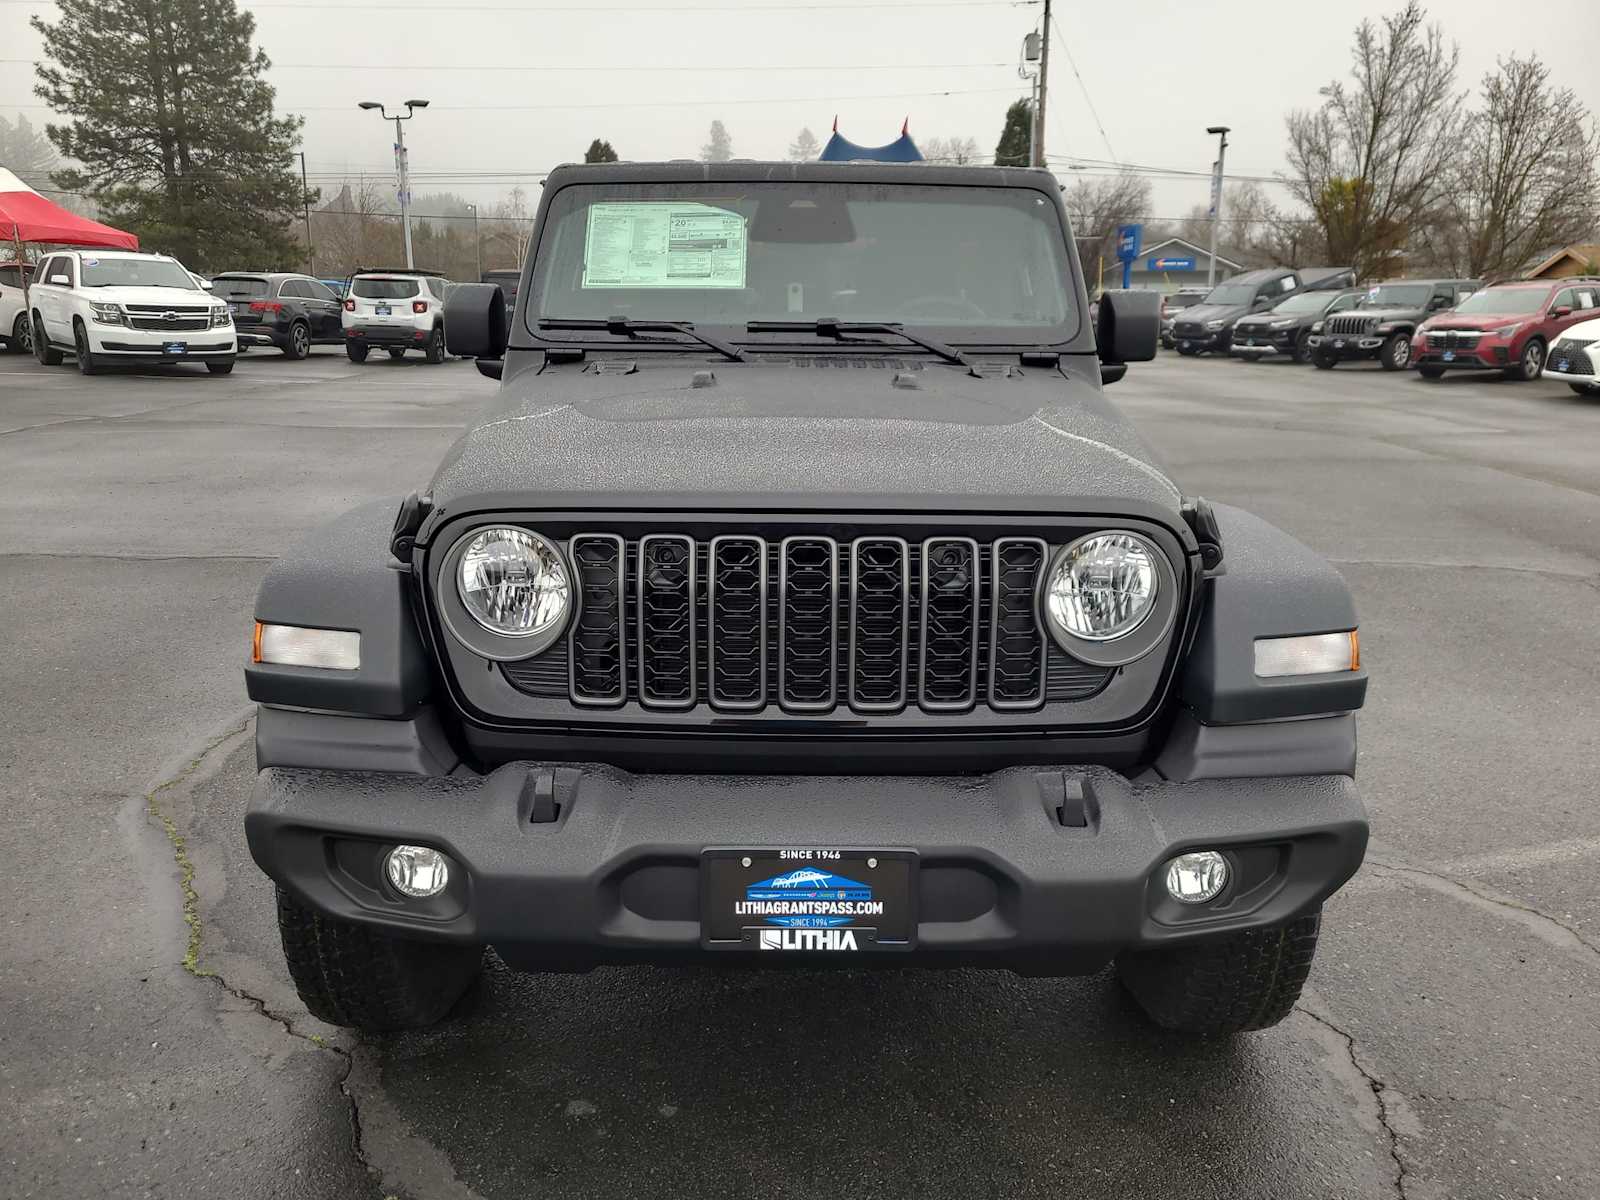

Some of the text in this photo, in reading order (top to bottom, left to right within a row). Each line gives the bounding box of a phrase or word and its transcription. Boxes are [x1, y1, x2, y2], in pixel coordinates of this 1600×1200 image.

[675, 219, 687, 227] 20
[780, 850, 841, 859] SINCE 1946
[735, 901, 883, 914] LITHIAGRANTSPASS.COM
[790, 918, 811, 927] SINCE
[782, 930, 858, 950] LITHIA
